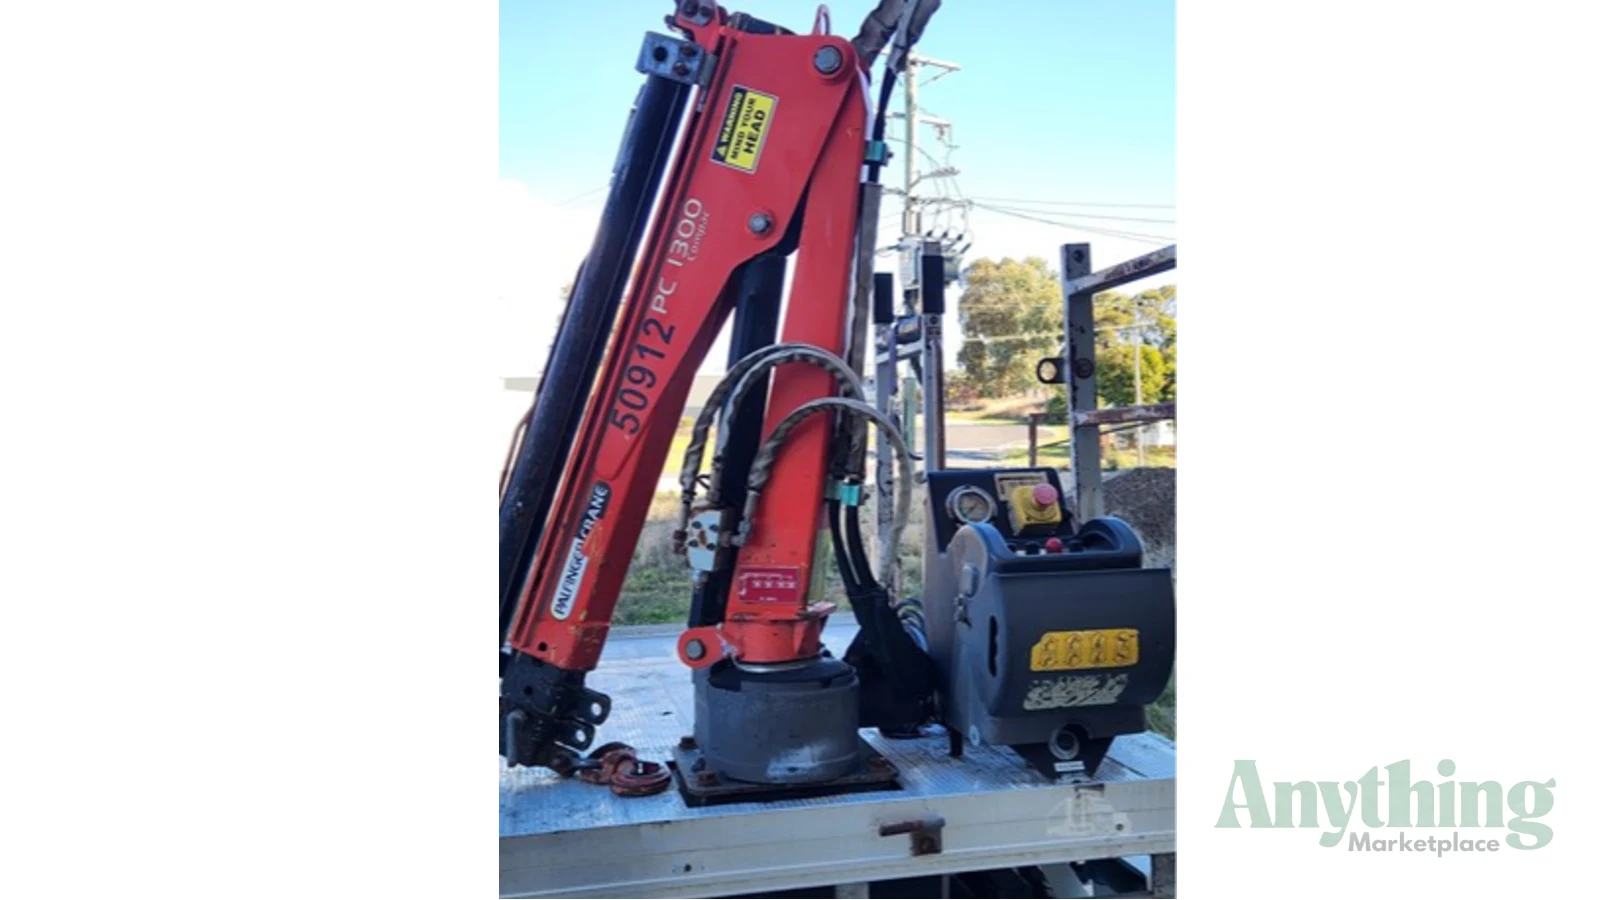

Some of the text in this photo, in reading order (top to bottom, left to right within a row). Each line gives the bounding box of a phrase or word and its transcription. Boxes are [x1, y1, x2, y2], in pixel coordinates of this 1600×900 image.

[721, 92, 743, 142] WARNING
[730, 98, 756, 159] MIND YOUR
[743, 109, 766, 154] HEAD
[651, 198, 702, 315] PC 1300
[610, 317, 676, 435] 50912
[580, 485, 609, 541] CRANE
